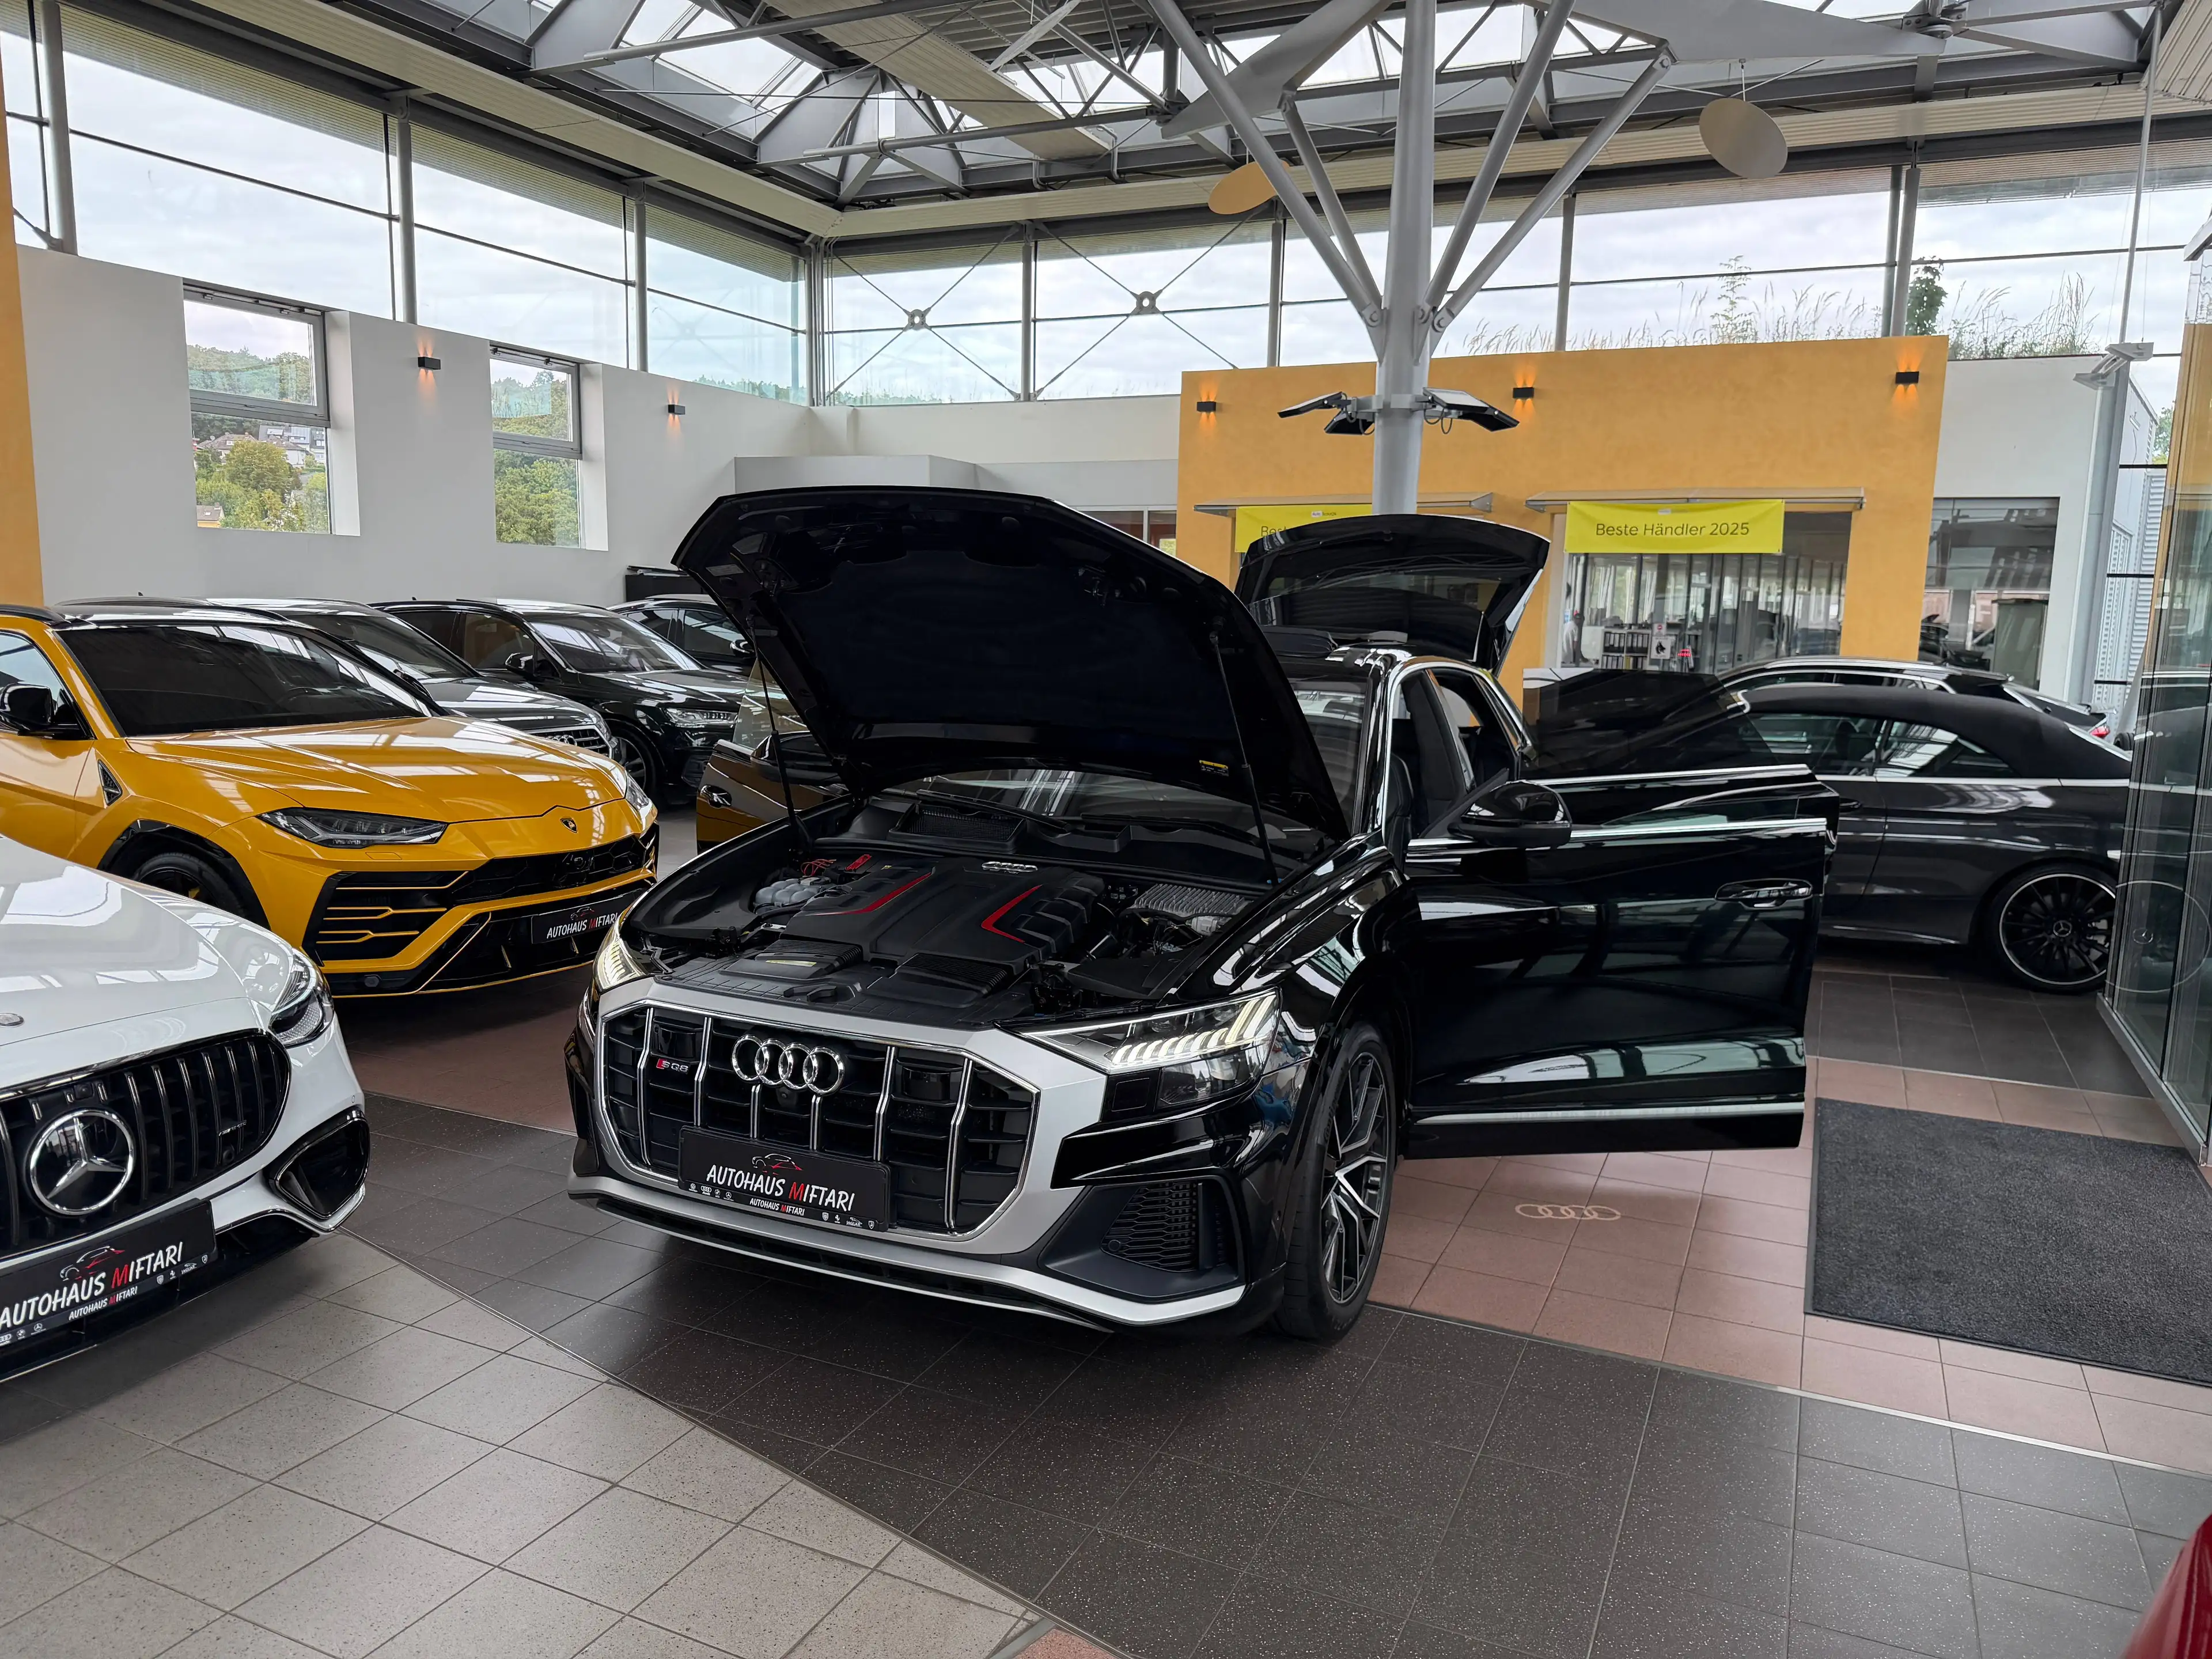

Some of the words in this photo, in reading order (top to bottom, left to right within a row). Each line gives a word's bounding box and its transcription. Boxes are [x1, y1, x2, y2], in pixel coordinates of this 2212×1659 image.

[1596, 523, 1639, 536] Beste
[1643, 522, 1706, 536] Händler
[1709, 522, 1749, 536] 2025
[547, 919, 587, 940] AUTOHAUS
[589, 912, 618, 929] MIFTARI
[661, 1060, 689, 1072] SQ8
[706, 1164, 785, 1196] AUTOHAUS
[789, 1181, 856, 1212] MIFTARI
[749, 1198, 780, 1210] AUTOHAUS
[781, 1205, 805, 1216] MIFTARI
[0, 1272, 106, 1331] AUTOHAUS
[111, 1241, 183, 1289] MIFTARI
[69, 1298, 108, 1321] AUTOHAUS
[108, 1286, 138, 1305] MIFTARI
